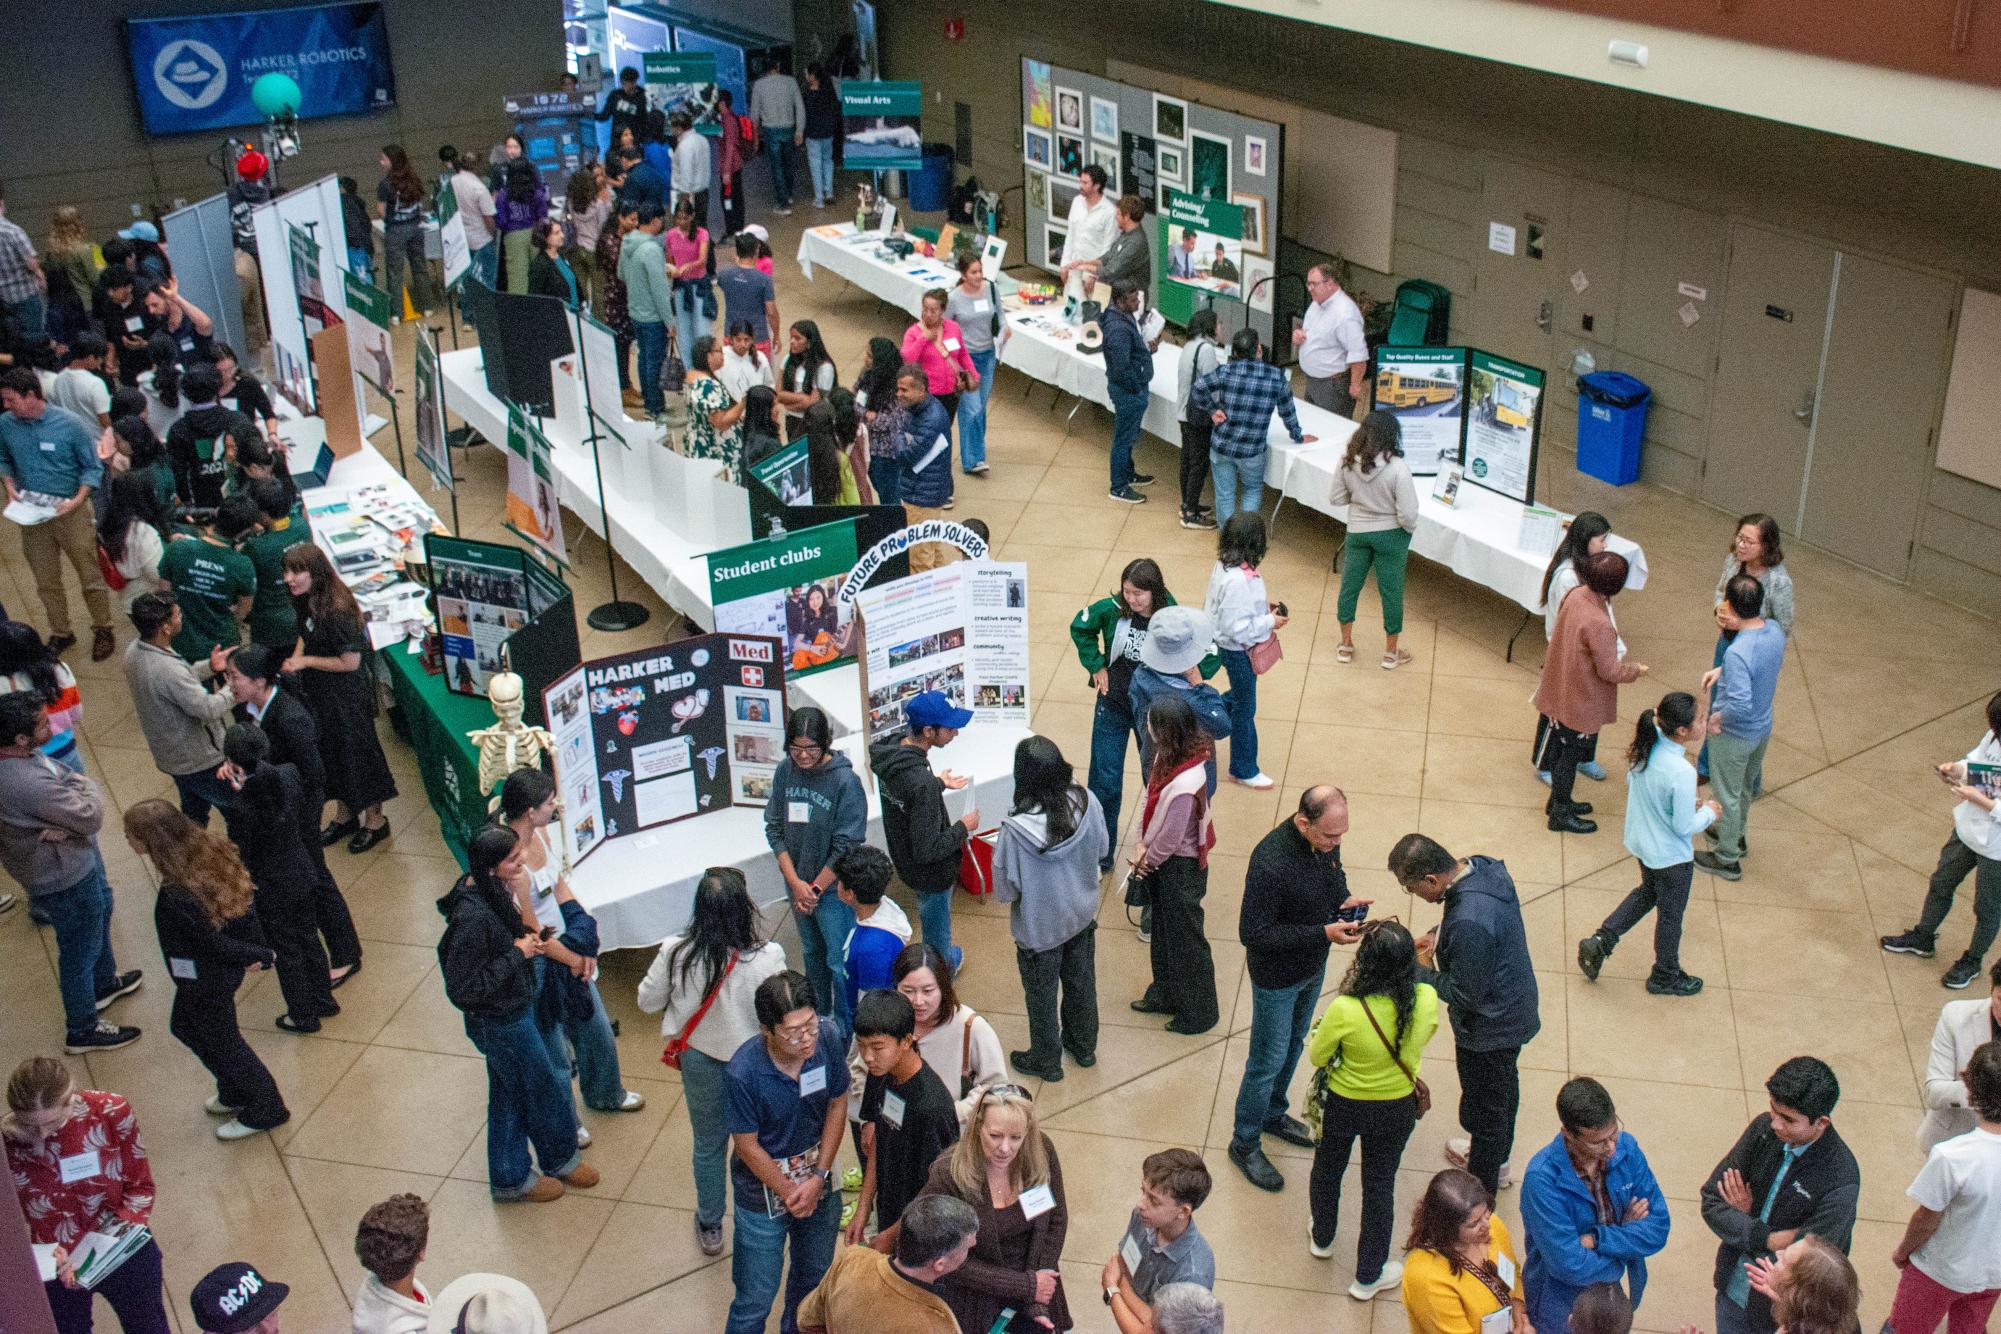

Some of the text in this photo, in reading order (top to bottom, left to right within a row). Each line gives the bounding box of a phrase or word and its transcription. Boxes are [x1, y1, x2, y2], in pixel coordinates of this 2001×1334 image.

[241, 47, 367, 70] HARKER ROBOTICS
[646, 65, 681, 74] Robotics
[844, 95, 891, 104] Visual Arts
[1172, 197, 1205, 215] Advising/
[1171, 209, 1209, 228] Counseling
[195, 559, 225, 572] PRESS
[713, 546, 821, 582] Student clubs
[841, 551, 880, 603] FUTURE
[943, 525, 986, 558] SOLVERS
[733, 643, 769, 659] Med
[588, 655, 674, 686] HARKER
[654, 671, 696, 694] MED
[785, 787, 831, 810] HARKER
